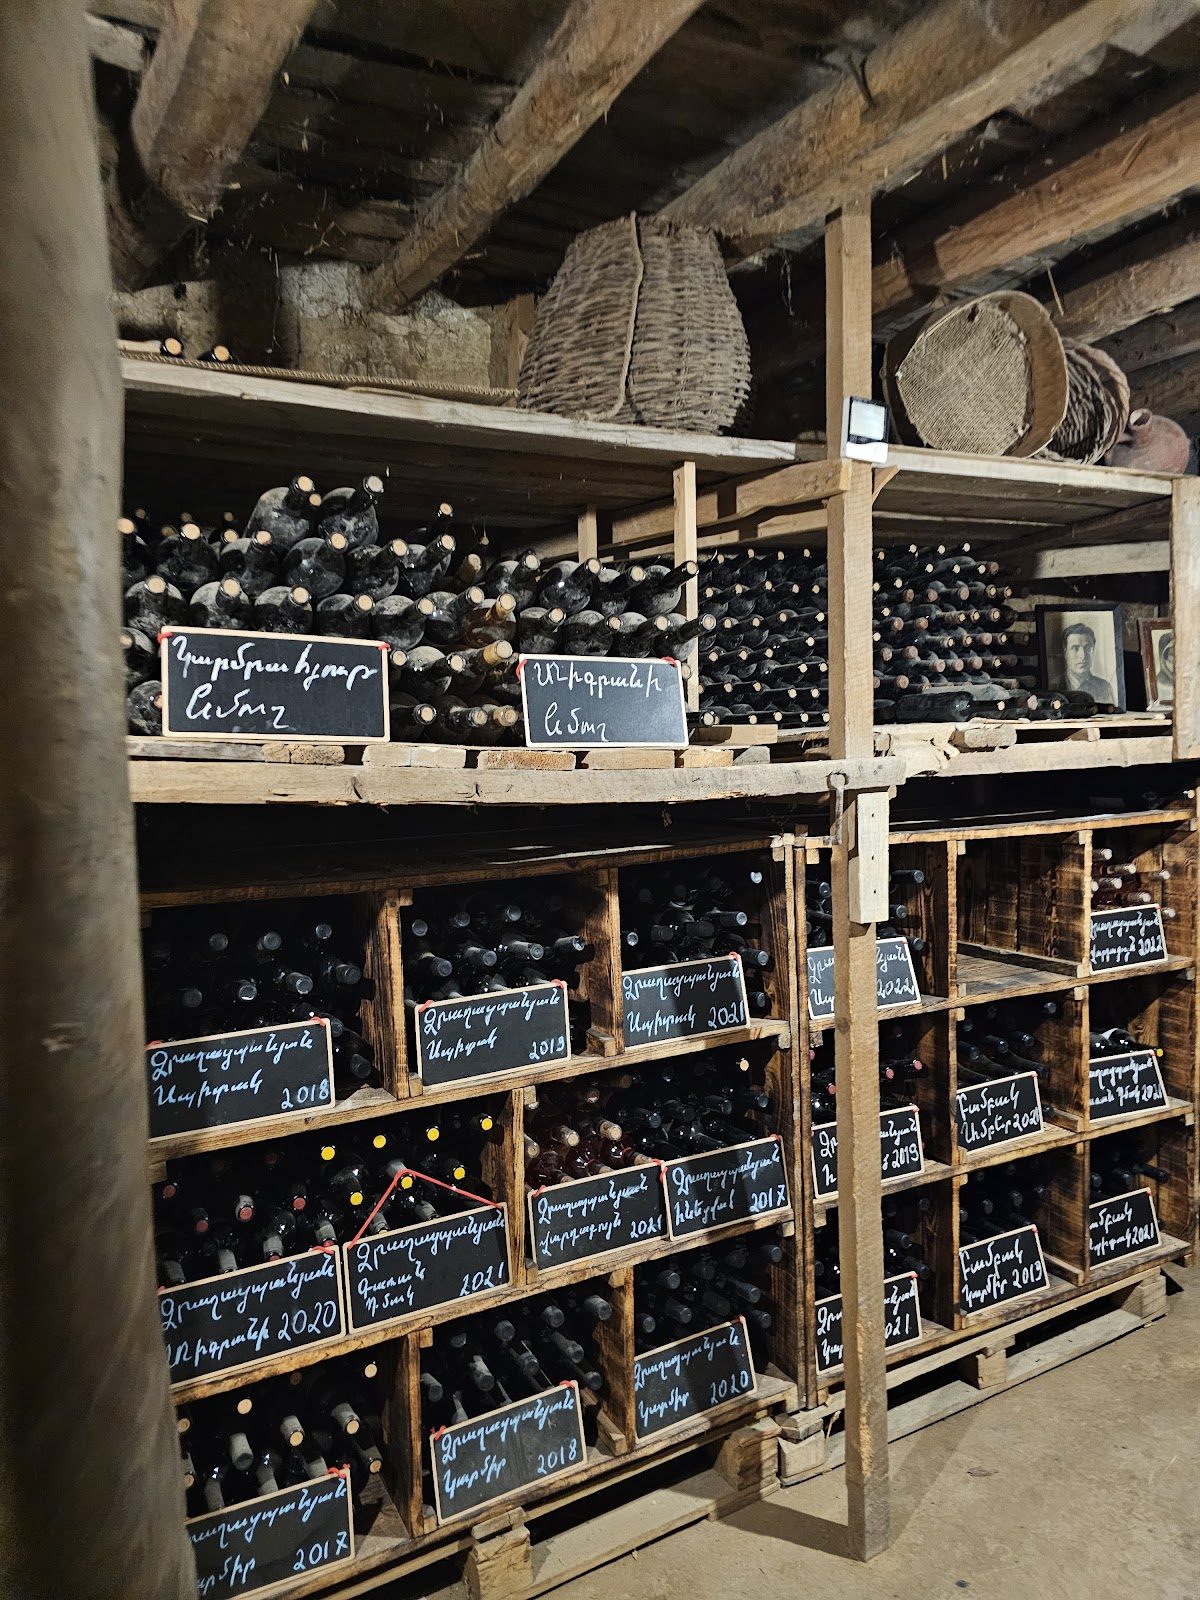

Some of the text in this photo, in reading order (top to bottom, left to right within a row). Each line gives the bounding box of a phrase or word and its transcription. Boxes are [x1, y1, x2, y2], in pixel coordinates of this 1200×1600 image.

[708, 1000, 744, 1028] 2021
[529, 1036, 565, 1060] 2019
[281, 1079, 329, 1109] 2018
[891, 1143, 919, 1169] 2019
[749, 1185, 785, 1212] 2017
[630, 1214, 662, 1239] 2021
[1132, 1223, 1154, 1244] 2021
[460, 1262, 504, 1296] 2021
[1012, 1260, 1042, 1288] 2019
[278, 1301, 336, 1341] 2020
[885, 1313, 910, 1339] 021
[711, 1370, 749, 1404] 2020
[537, 1439, 577, 1474] 2018
[293, 1531, 348, 1571] 2017
